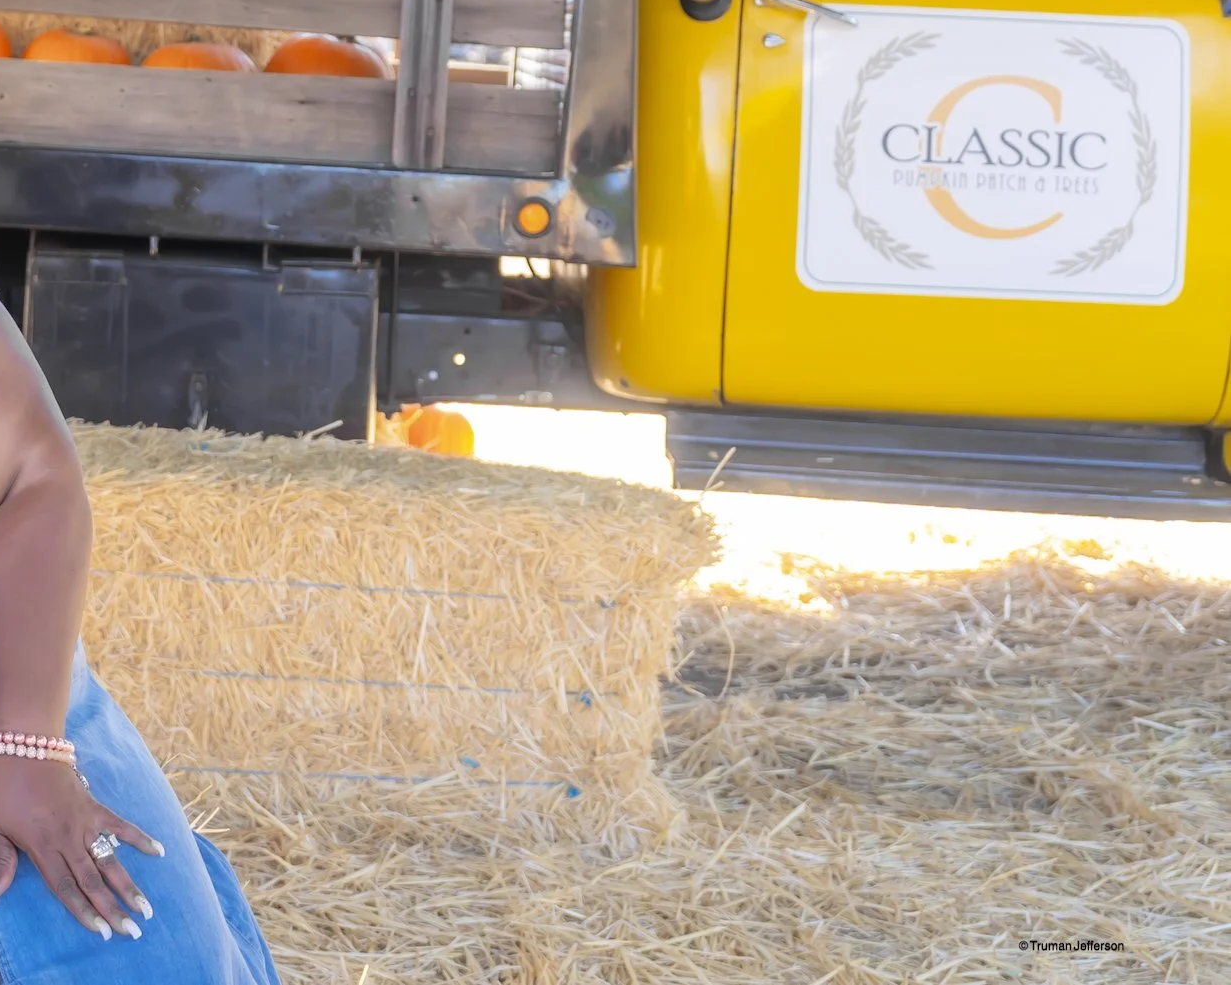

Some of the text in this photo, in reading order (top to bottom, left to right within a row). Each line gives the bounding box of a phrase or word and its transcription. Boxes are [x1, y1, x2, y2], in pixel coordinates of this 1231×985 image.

[881, 123, 1108, 171] CLASSIC
[892, 168, 968, 189] PUMPKIN
[976, 171, 1027, 191] PATCH
[1055, 175, 1100, 196] TREES
